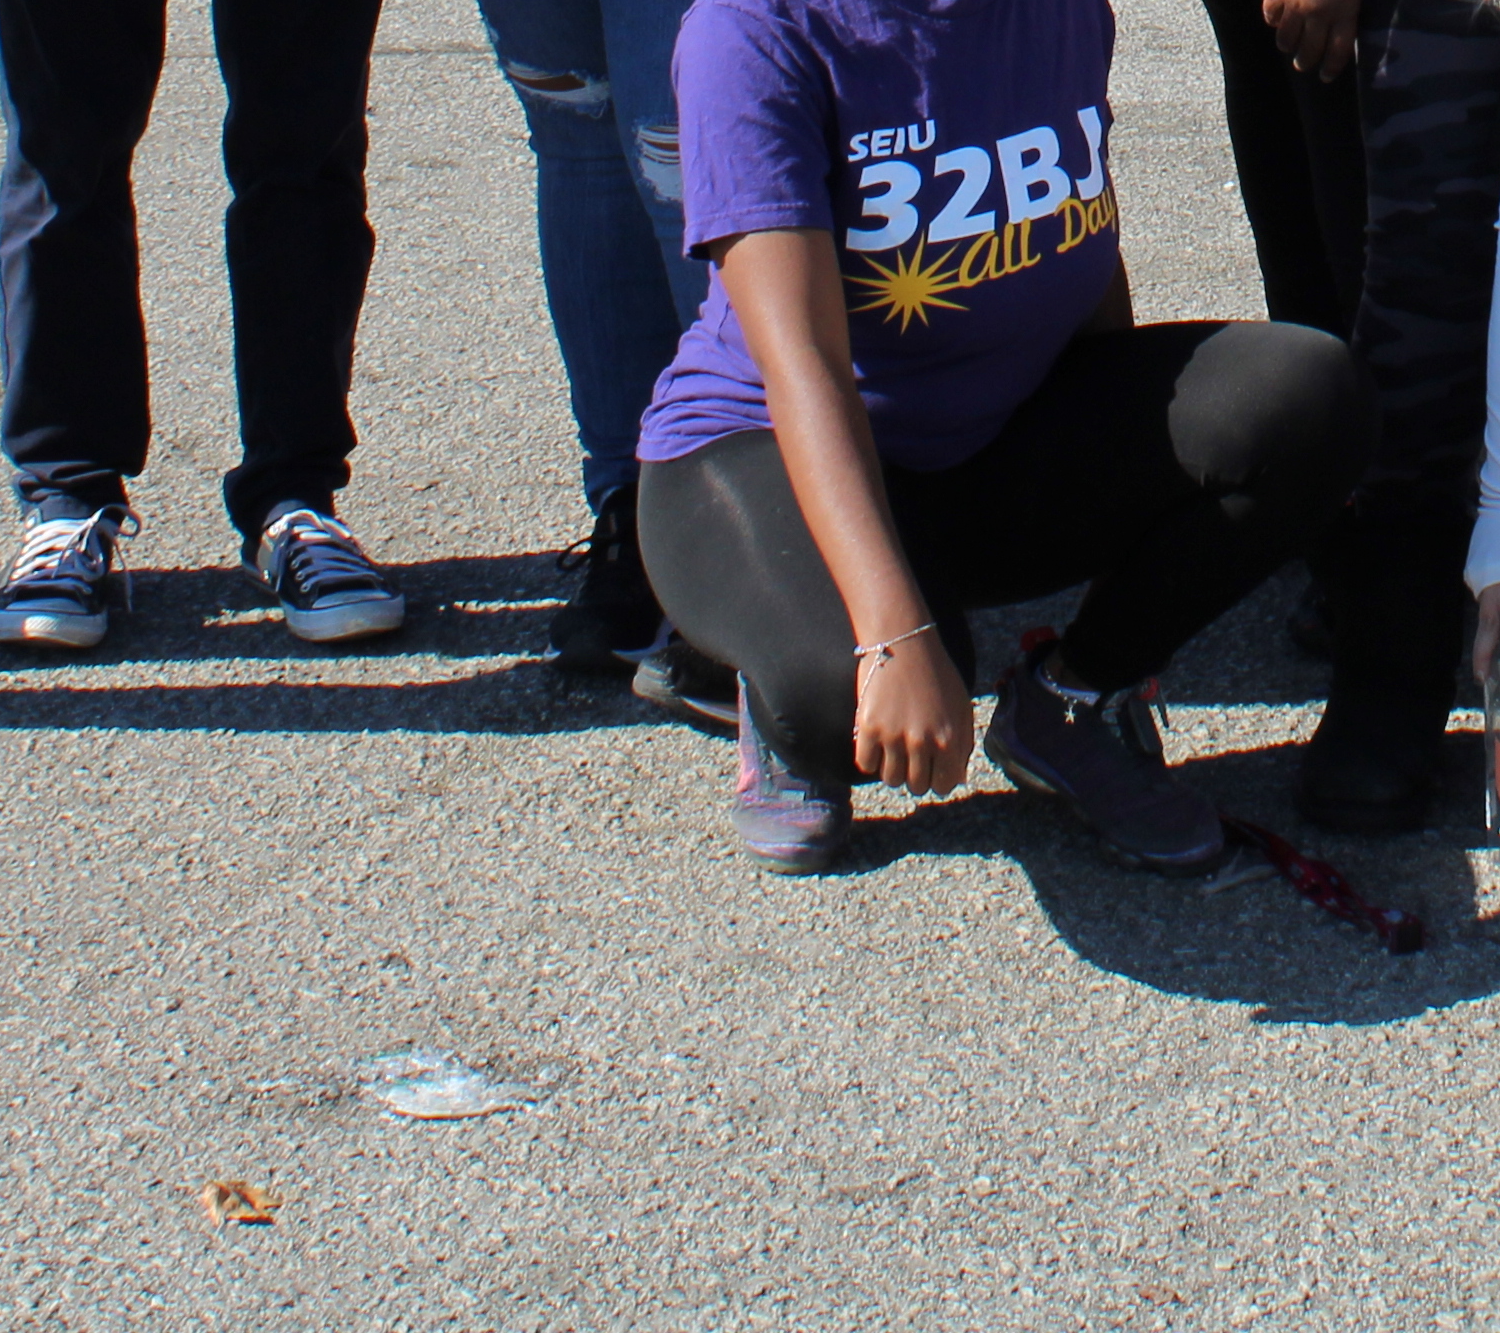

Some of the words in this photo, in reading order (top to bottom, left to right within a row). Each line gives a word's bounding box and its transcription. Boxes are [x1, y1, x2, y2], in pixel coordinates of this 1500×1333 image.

[847, 119, 937, 163] SEIU
[845, 106, 1105, 252] 32BJ
[959, 217, 1042, 288] all
